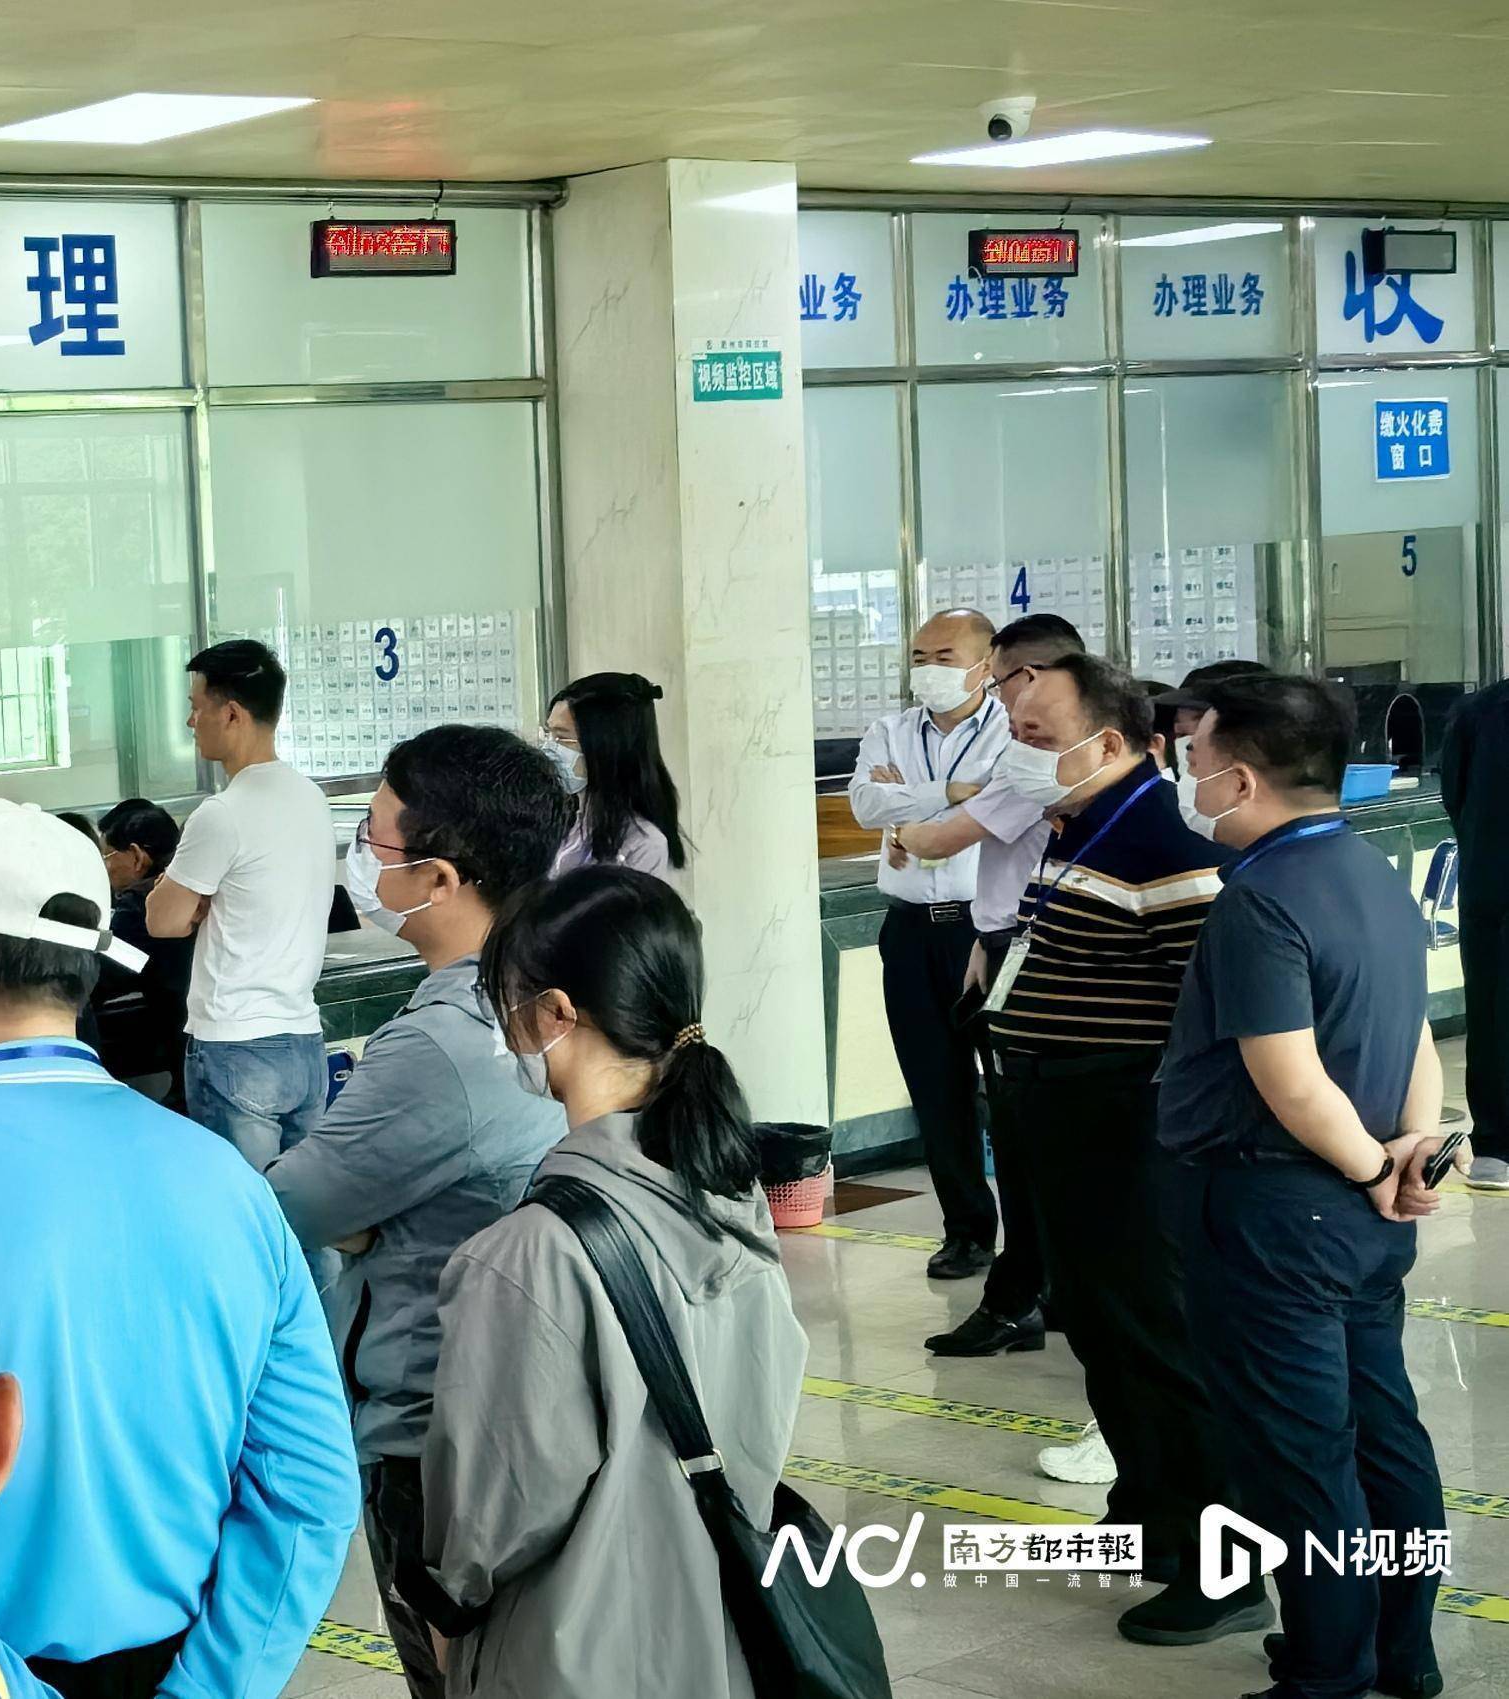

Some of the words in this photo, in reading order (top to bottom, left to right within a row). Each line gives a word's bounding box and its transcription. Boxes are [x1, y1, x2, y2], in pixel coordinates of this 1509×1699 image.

[799, 272, 863, 322] 业务
[946, 274, 1070, 322] 办理业务
[1152, 272, 1264, 317] 办理业务
[1343, 228, 1445, 345] 收
[698, 360, 778, 393] 视频监控区域
[1380, 409, 1443, 437] 缴火化费
[1390, 443, 1432, 470] 窗口
[1401, 535, 1417, 577] 5
[1010, 567, 1031, 613] 4
[374, 627, 400, 682] 3
